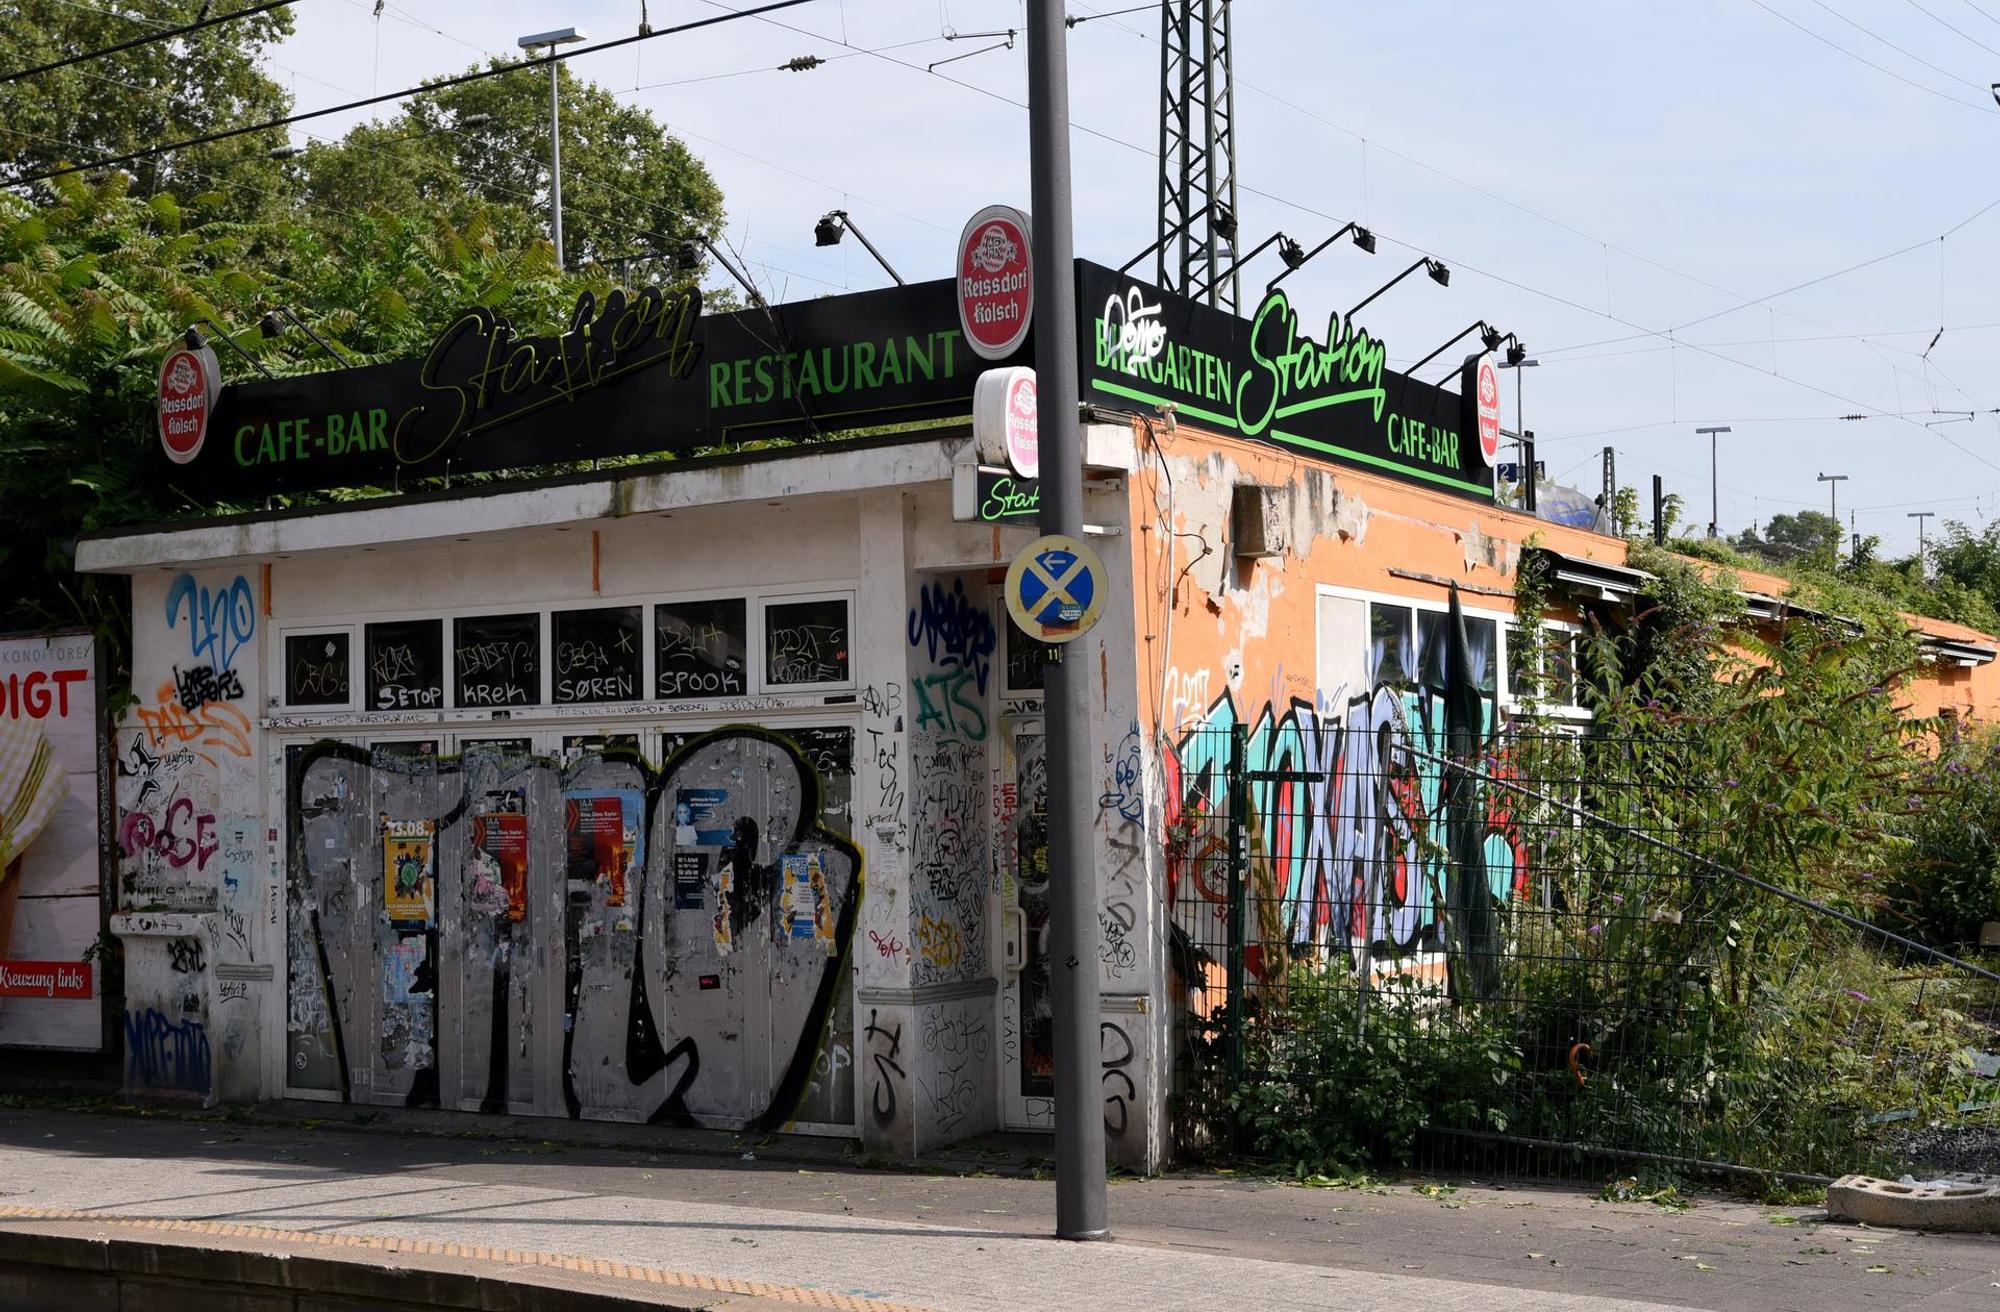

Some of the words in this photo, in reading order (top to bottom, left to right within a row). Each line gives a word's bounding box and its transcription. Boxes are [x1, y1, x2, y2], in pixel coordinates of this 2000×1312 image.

[963, 267, 1028, 298] Reissdorf
[975, 297, 1019, 324] Kölsch
[709, 329, 962, 409] RESTAURANT
[1236, 292, 1386, 436] Station
[162, 391, 205, 414] Reissdorf
[233, 408, 390, 467] CAFE-BAR
[1387, 413, 1460, 470] CAFE-BAR
[982, 477, 1040, 520] Stat
[0, 669, 88, 719] IGT
[659, 671, 740, 694] SPOOK
[911, 665, 987, 741] ATS
[0, 966, 54, 997] Kreuzung
[58, 967, 84, 990] links
